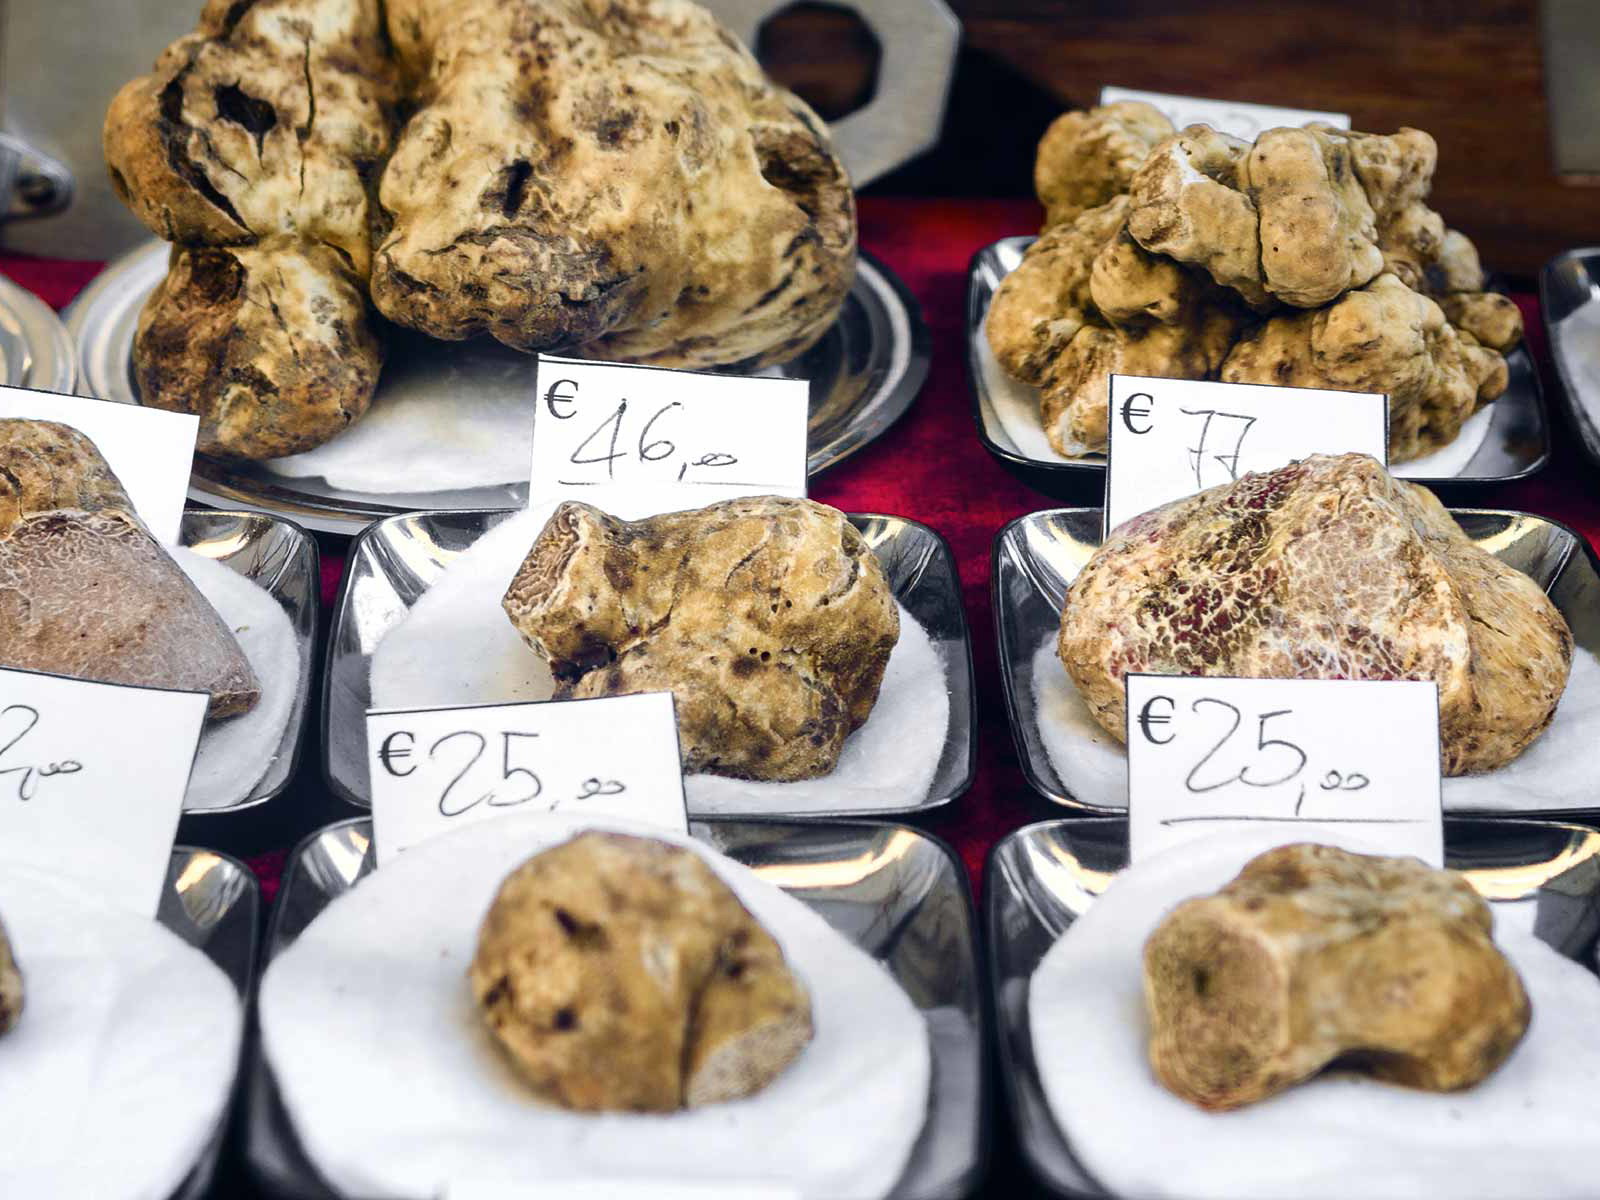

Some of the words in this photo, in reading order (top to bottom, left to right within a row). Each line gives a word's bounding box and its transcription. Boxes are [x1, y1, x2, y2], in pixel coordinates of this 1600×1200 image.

[544, 379, 578, 419] €
[1119, 392, 1154, 434] €
[377, 731, 417, 777] €
[1137, 695, 1176, 745] €
[1185, 697, 1370, 817] 25,00
